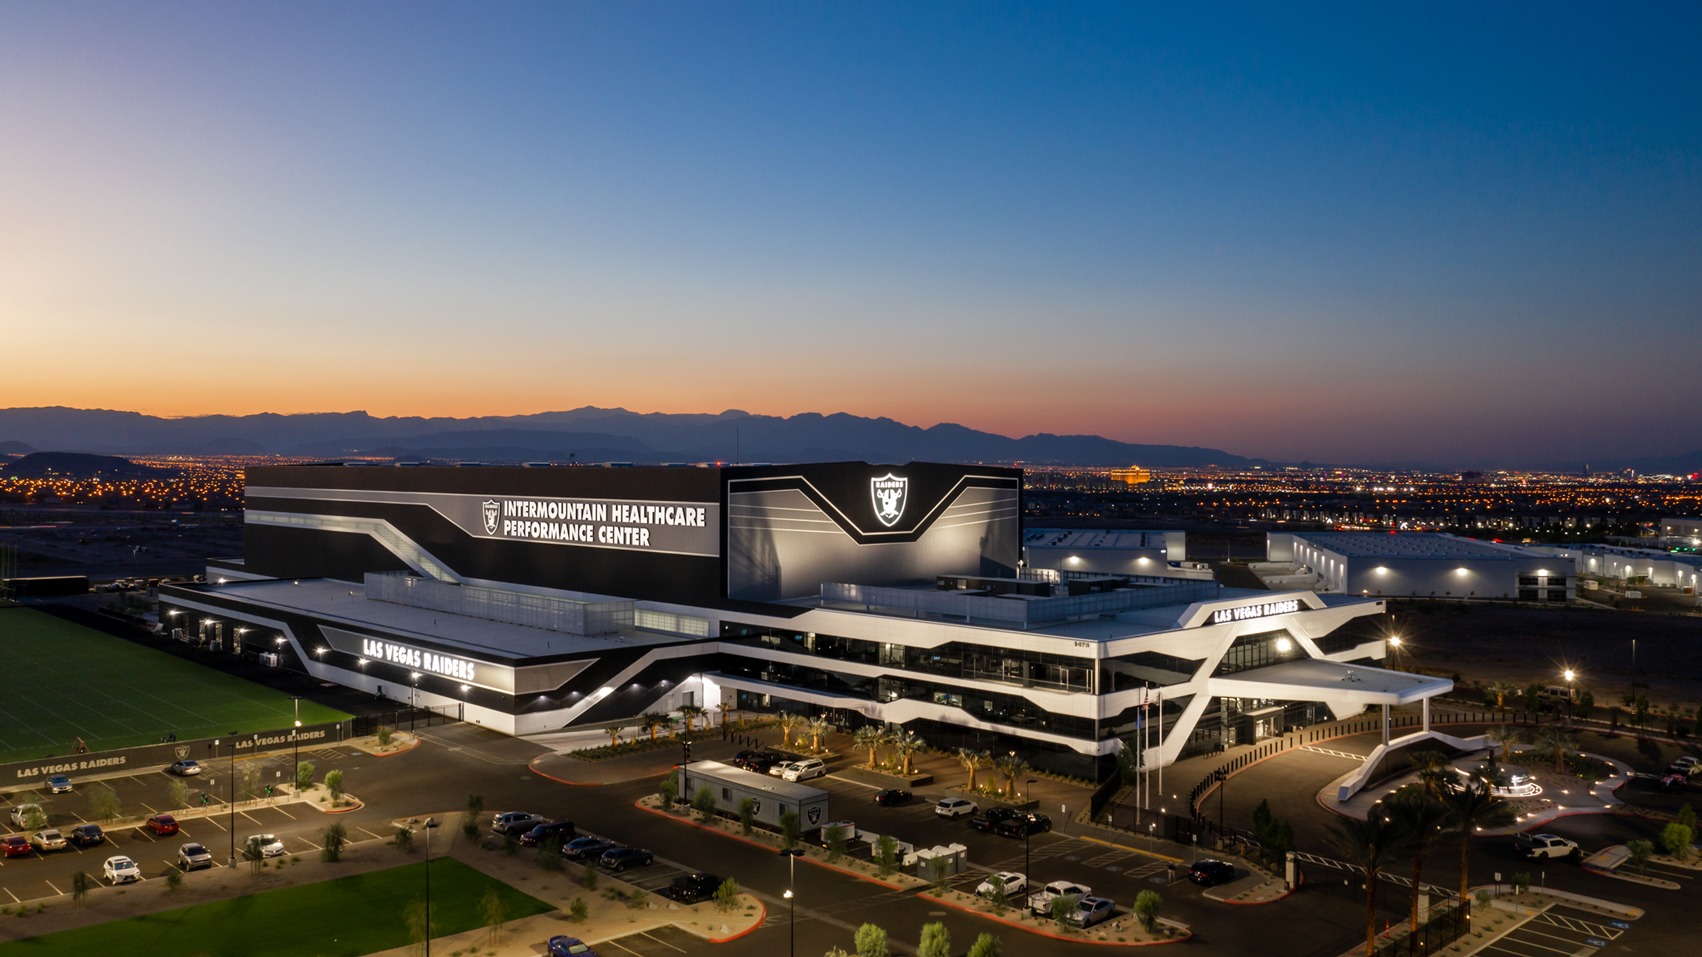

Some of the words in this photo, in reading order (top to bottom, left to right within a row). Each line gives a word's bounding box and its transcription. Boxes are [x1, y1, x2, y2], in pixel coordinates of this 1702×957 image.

[504, 500, 607, 522] INTERMOUNTAIN
[612, 504, 706, 527] HEALTHCARE
[503, 520, 594, 543] PERFORMANCE
[598, 525, 650, 547] CENTER
[1214, 610, 1232, 623] LAS
[1233, 604, 1262, 620] VEGAS
[1263, 600, 1298, 615] RAIDERS
[363, 639, 383, 658] LAS
[385, 643, 421, 668] VEGAS
[423, 652, 475, 681] RAIDERS
[235, 740, 253, 749] LAS
[254, 735, 286, 746] VEGAS
[17, 767, 39, 778] LAS
[40, 762, 78, 775] VEGAS
[80, 756, 126, 769] RAIDERS
